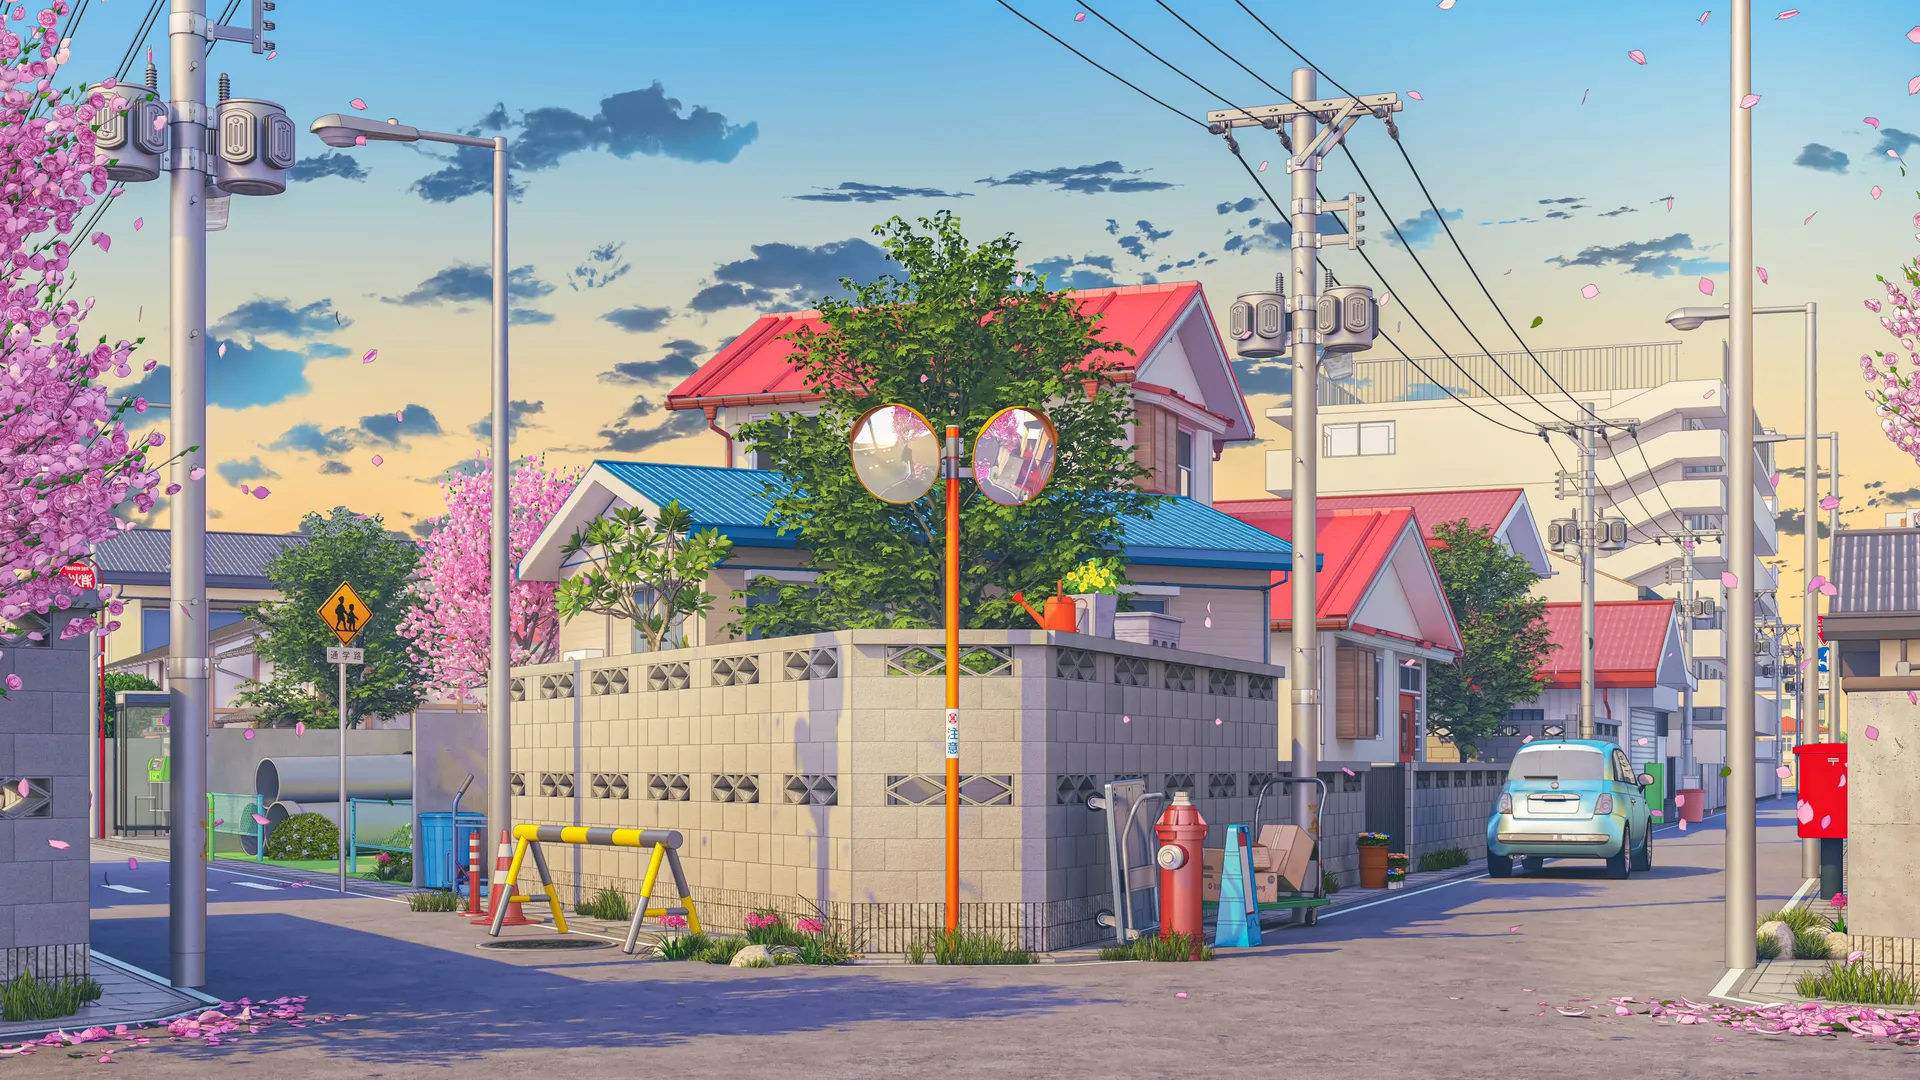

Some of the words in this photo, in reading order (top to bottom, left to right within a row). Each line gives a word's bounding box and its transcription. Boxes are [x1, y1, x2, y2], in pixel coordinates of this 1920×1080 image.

[330, 650, 362, 660] 通学路
[947, 727, 958, 754] 注意
